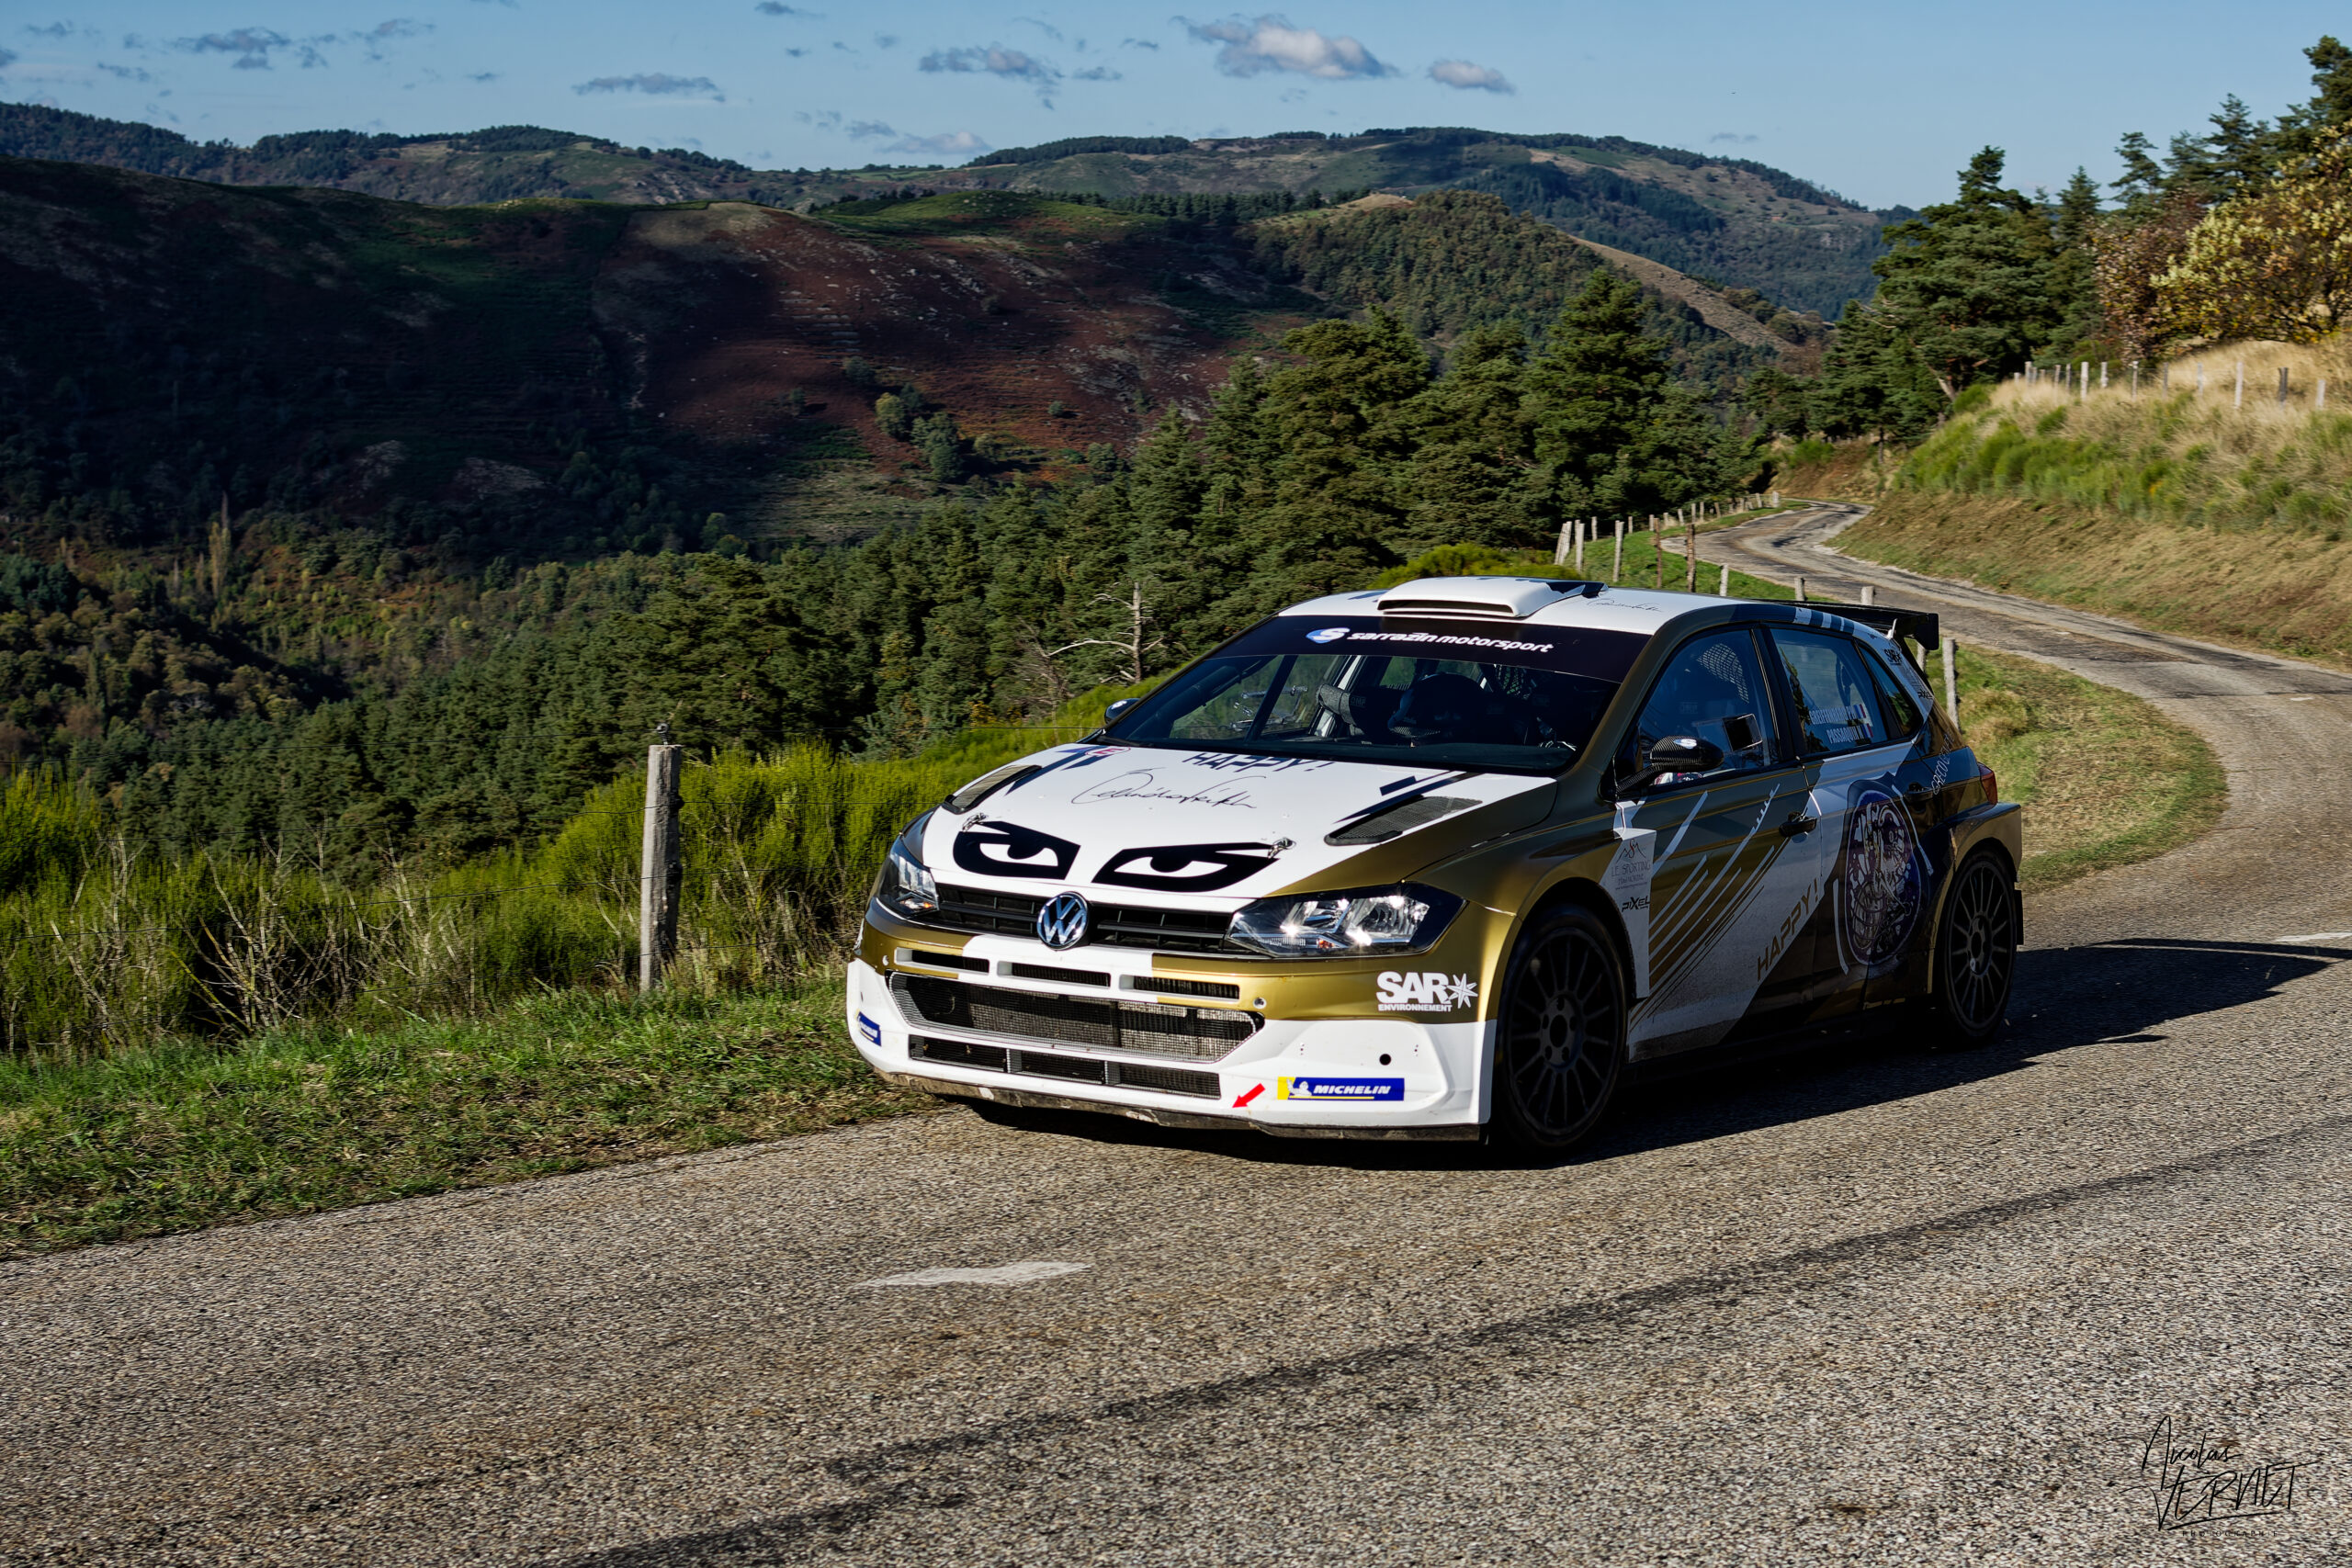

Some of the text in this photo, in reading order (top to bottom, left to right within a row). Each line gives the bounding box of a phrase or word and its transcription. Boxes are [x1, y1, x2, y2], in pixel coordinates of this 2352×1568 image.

[1436, 636, 1555, 653] motorsport
[1376, 971, 1452, 1004] SAR
[1378, 1003, 1453, 1012] ENVIRONNEMENT
[1313, 1085, 1391, 1095] MICHELIN
